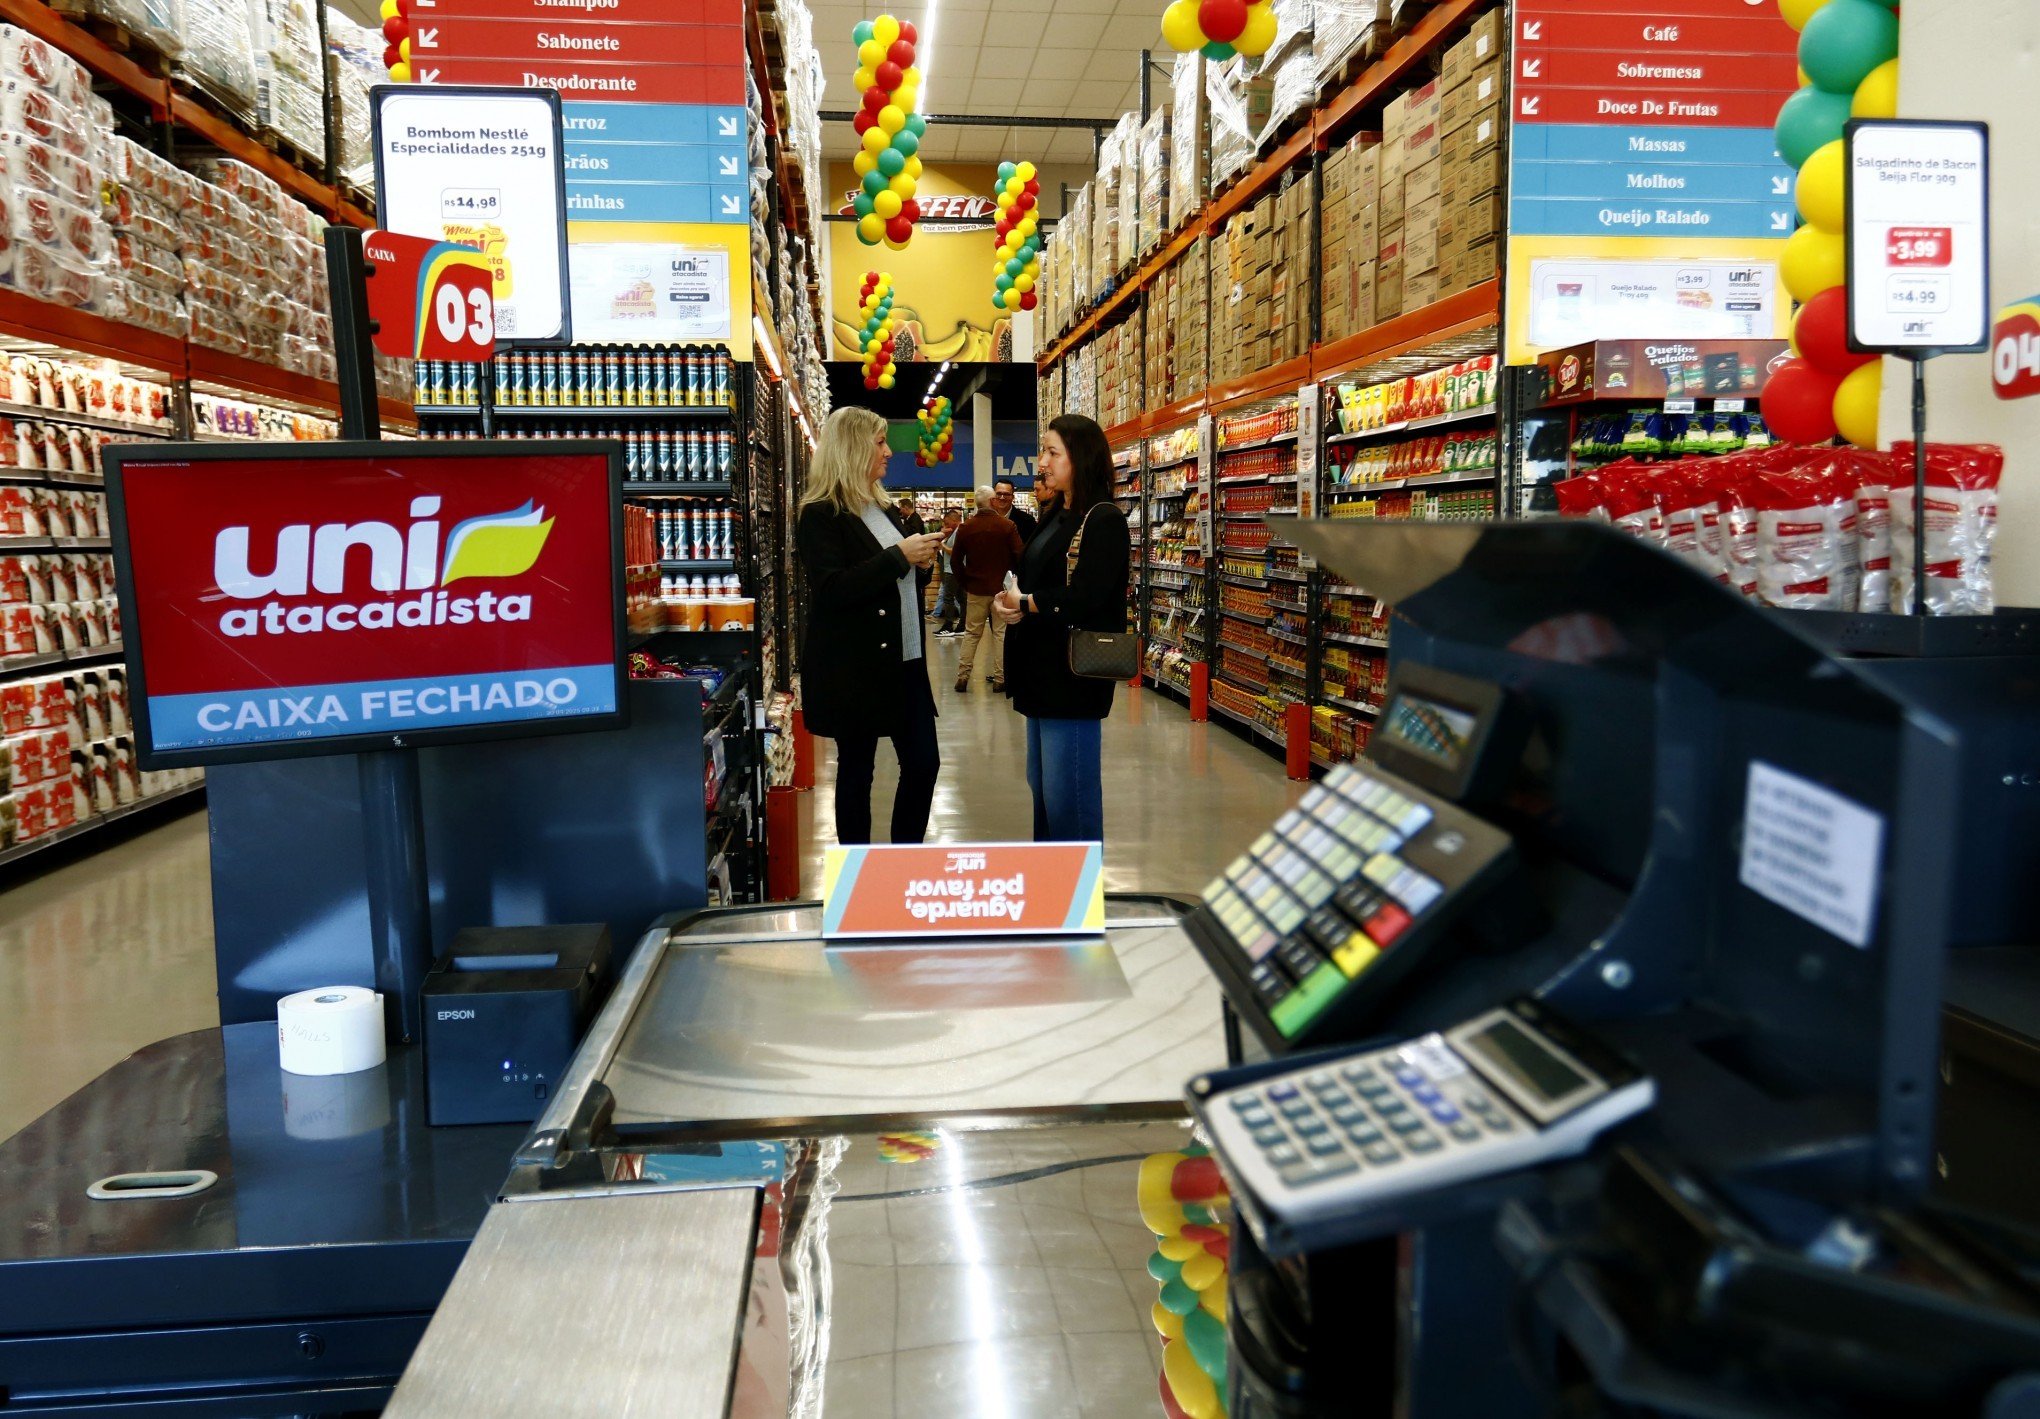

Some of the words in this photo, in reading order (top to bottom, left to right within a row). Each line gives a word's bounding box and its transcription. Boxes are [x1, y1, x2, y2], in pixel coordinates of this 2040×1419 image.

[537, 32, 620, 50] Sabonete
[1643, 26, 1678, 41] Café
[1617, 62, 1702, 79] Sobremesa
[521, 72, 637, 91] Desodorante
[1598, 99, 1637, 116] Doce
[1641, 100, 1664, 116] De
[1669, 101, 1718, 117] Frutas
[562, 115, 607, 130] Arroz
[407, 127, 476, 140] Bombom
[480, 127, 529, 141] Nestlé
[391, 141, 507, 156] Especialidades
[511, 145, 546, 158] 251g
[1628, 137, 1686, 153] Massas
[1857, 157, 1922, 170] Salgadinho
[1925, 159, 1940, 169] de
[1942, 159, 1977, 170] Bacon
[1627, 173, 1685, 189] Molhos
[1879, 171, 1907, 184] Beija
[1911, 172, 1933, 182] Flor
[567, 193, 625, 209] rinhas
[1599, 208, 1651, 226] Queijo
[1655, 209, 1710, 225] Ralado
[957, 223, 977, 232] para
[367, 247, 396, 263] CAIXA
[672, 257, 697, 272] uni
[1728, 269, 1751, 282] uni
[1611, 284, 1633, 292] Queijo
[436, 283, 494, 346] 03
[1644, 344, 1696, 359] Queijos
[1650, 353, 1699, 366] ralados
[1993, 332, 2040, 386] 04
[997, 456, 1039, 476] LAT
[214, 495, 441, 599] uni
[219, 590, 532, 637] atacadista
[197, 694, 349, 732] CAIXA
[361, 677, 578, 720] FECHADO
[957, 858, 986, 873] uni
[904, 879, 975, 901] favor
[978, 872, 1024, 896] por
[904, 896, 1025, 923] Aguarde,
[437, 1010, 475, 1021] EPSON
